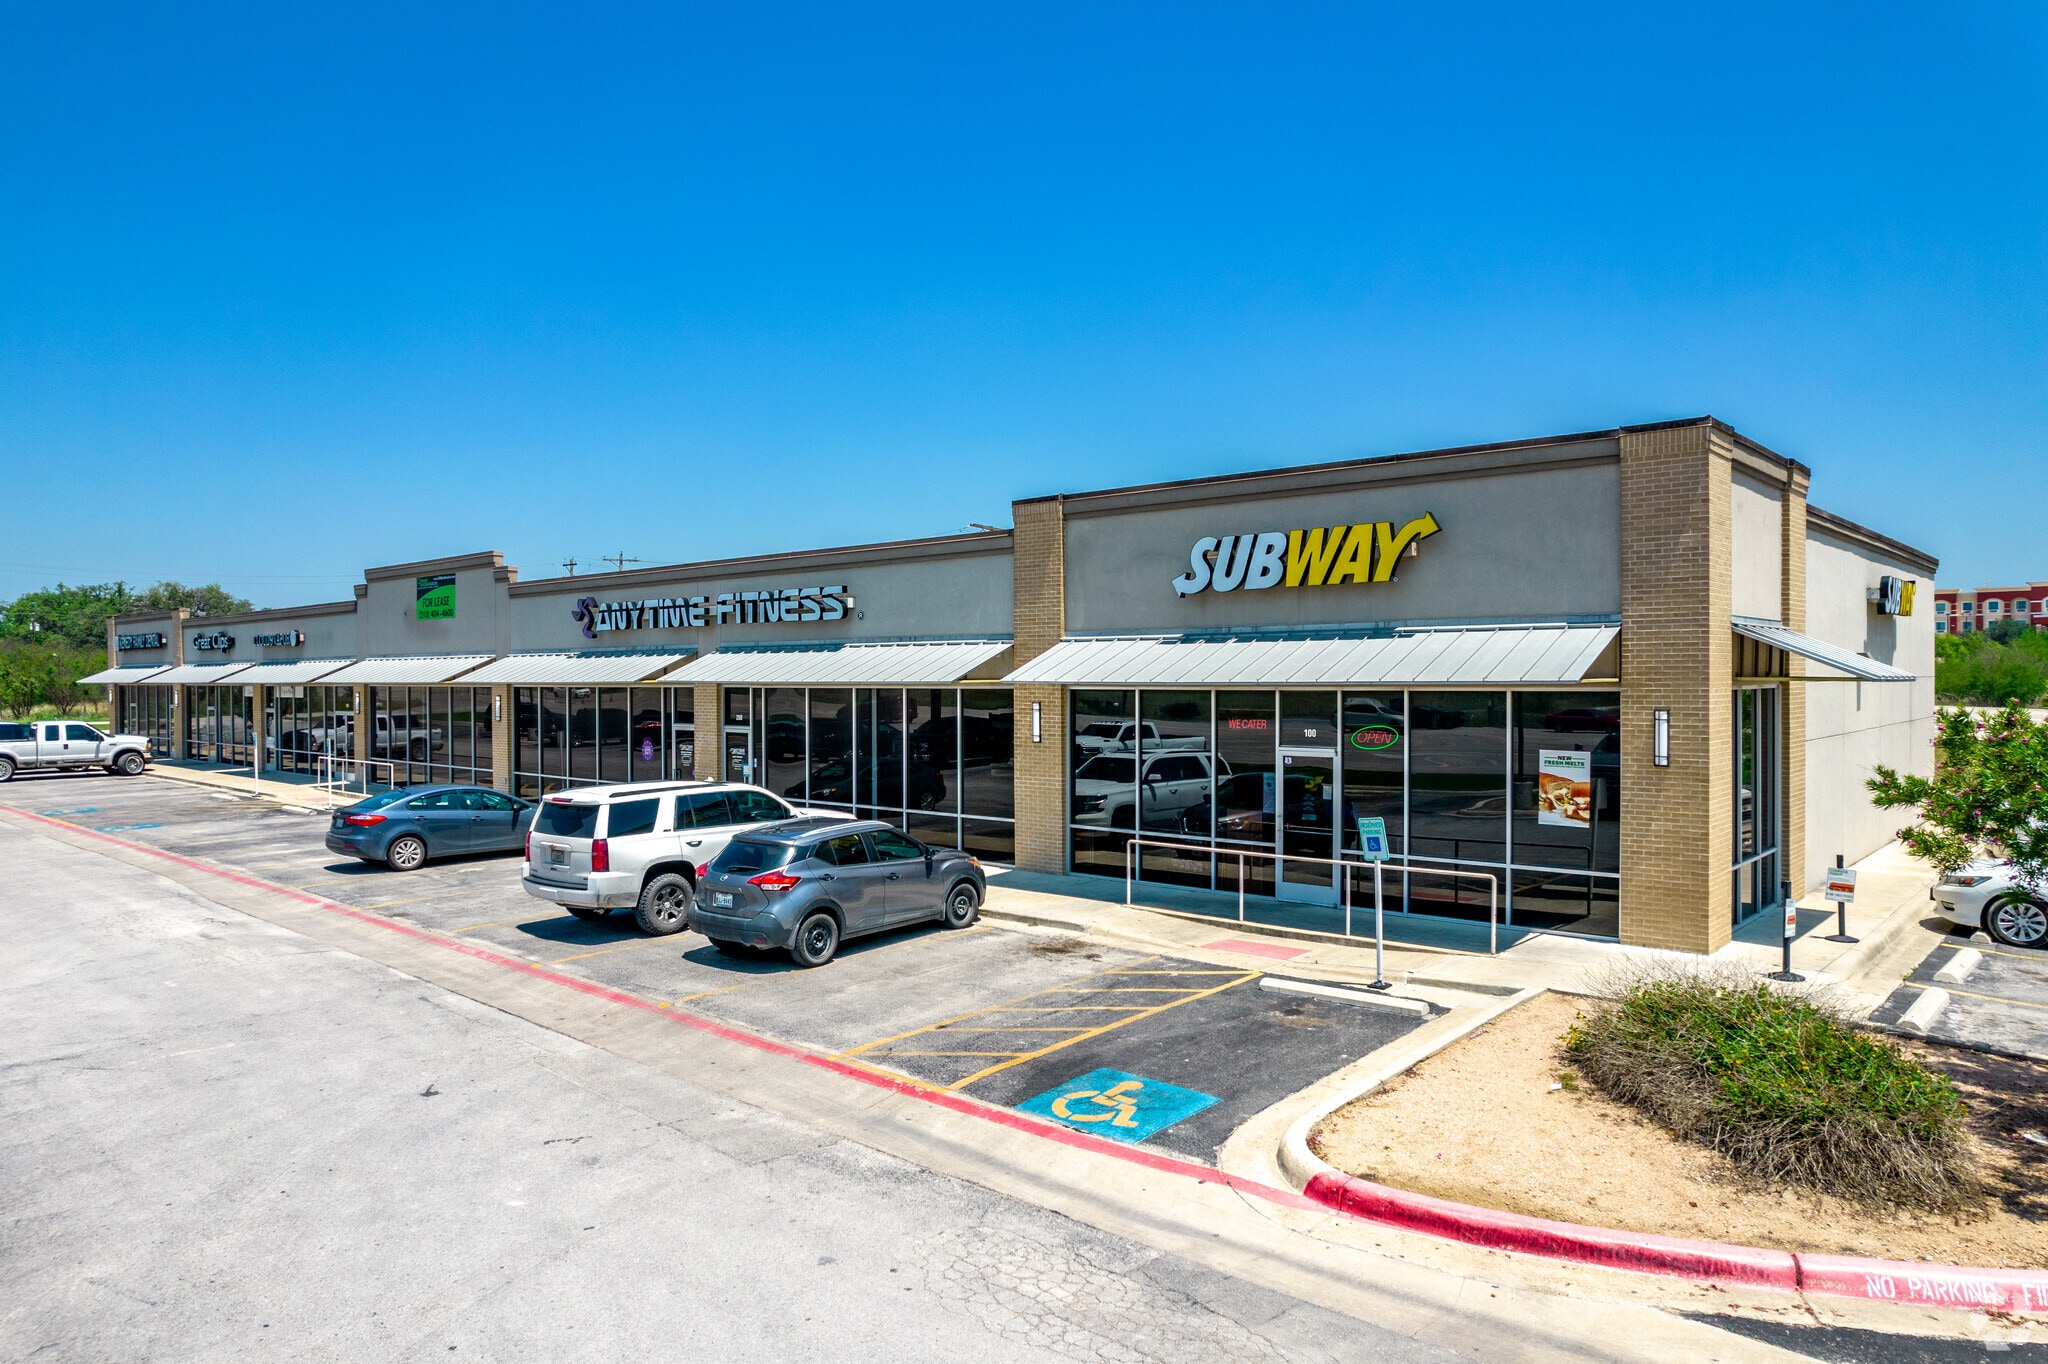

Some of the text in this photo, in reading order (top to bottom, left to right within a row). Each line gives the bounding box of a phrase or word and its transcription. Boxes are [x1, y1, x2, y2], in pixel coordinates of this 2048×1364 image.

[1170, 511, 1442, 598] SUBWAY
[422, 595, 450, 608] FOR LEASE
[1885, 576, 1917, 616] SUBWAY
[596, 585, 845, 632] ANYTIME FITNESS
[193, 633, 229, 653] Great Clips
[1228, 719, 1267, 730] WE CATER
[1303, 729, 1317, 738] 100
[1356, 731, 1392, 745] OPEN
[1866, 1274, 1896, 1299] NO
[1908, 1276, 1998, 1305] PARKING
